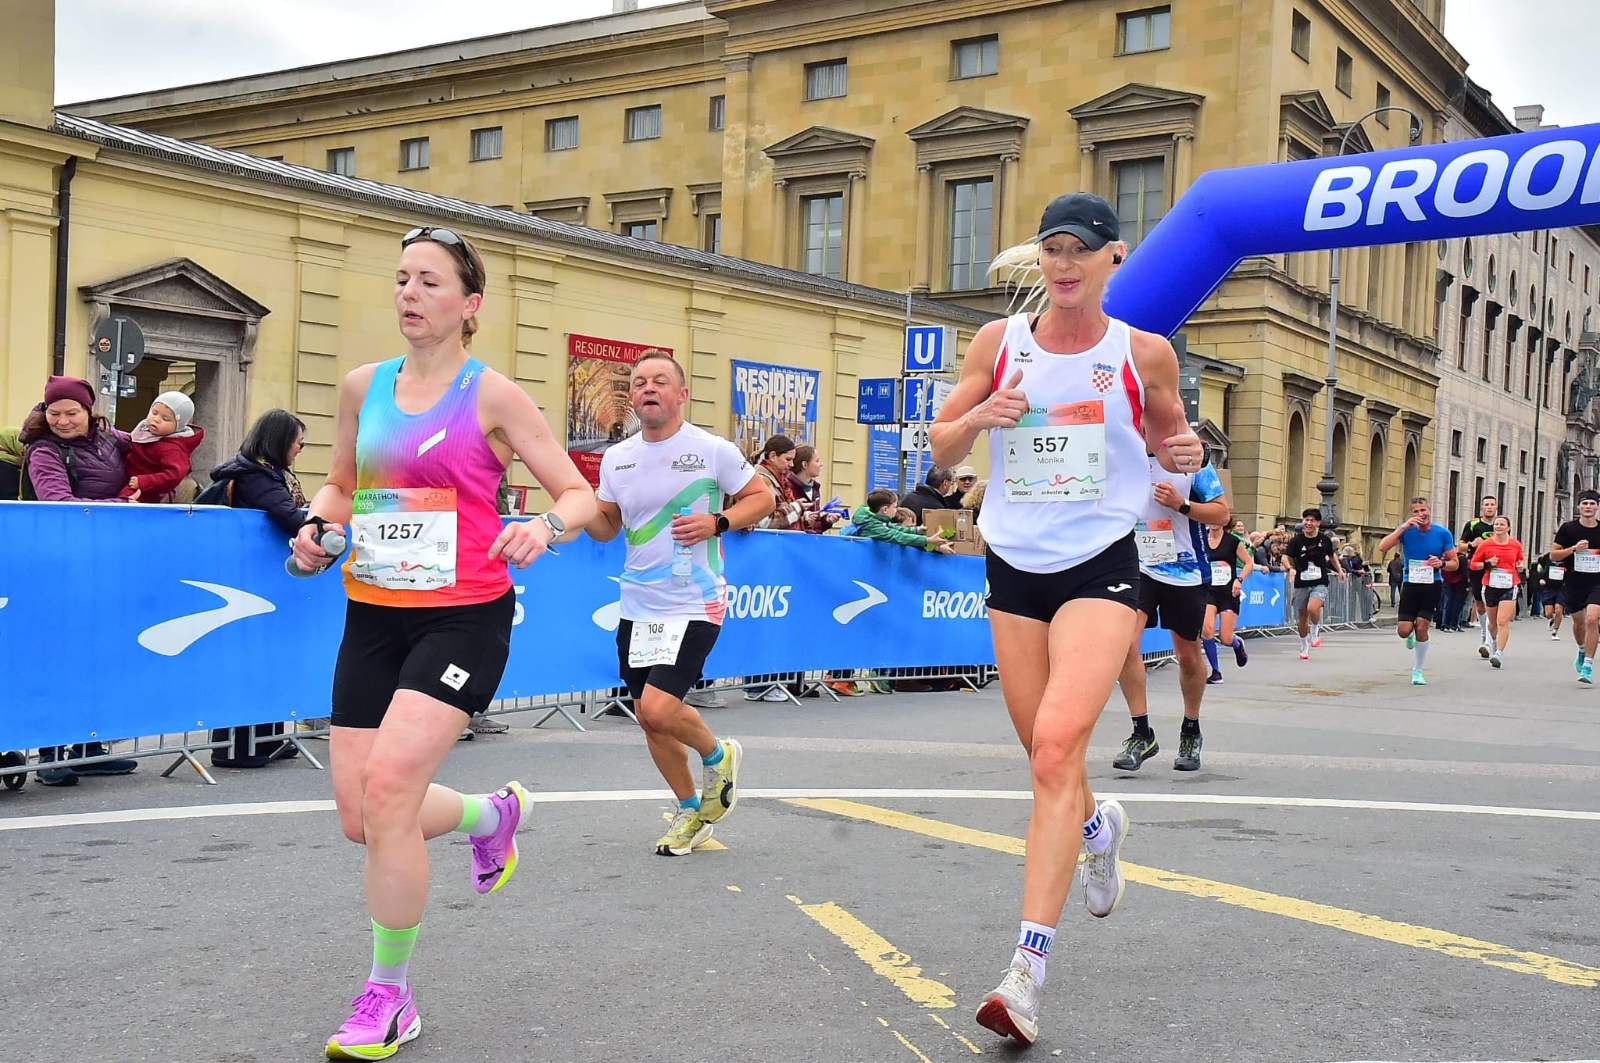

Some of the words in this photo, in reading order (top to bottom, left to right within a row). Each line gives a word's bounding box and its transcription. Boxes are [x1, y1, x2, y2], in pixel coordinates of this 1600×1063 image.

[574, 340, 621, 359] RESIDENZ
[914, 332, 936, 365] U
[736, 366, 816, 401] RESIDENZ
[861, 385, 874, 396] Lift
[744, 391, 807, 423] WOCHE
[913, 435, 929, 444] BS
[1032, 436, 1069, 453] 557
[1009, 448, 1016, 456] A
[358, 492, 399, 502] MARATHON
[358, 534, 365, 543] A
[378, 523, 424, 540] 1257
[1141, 535, 1158, 544] 272
[725, 584, 793, 619] ROOKS
[922, 590, 990, 619] BROOK
[648, 623, 665, 634] 108
